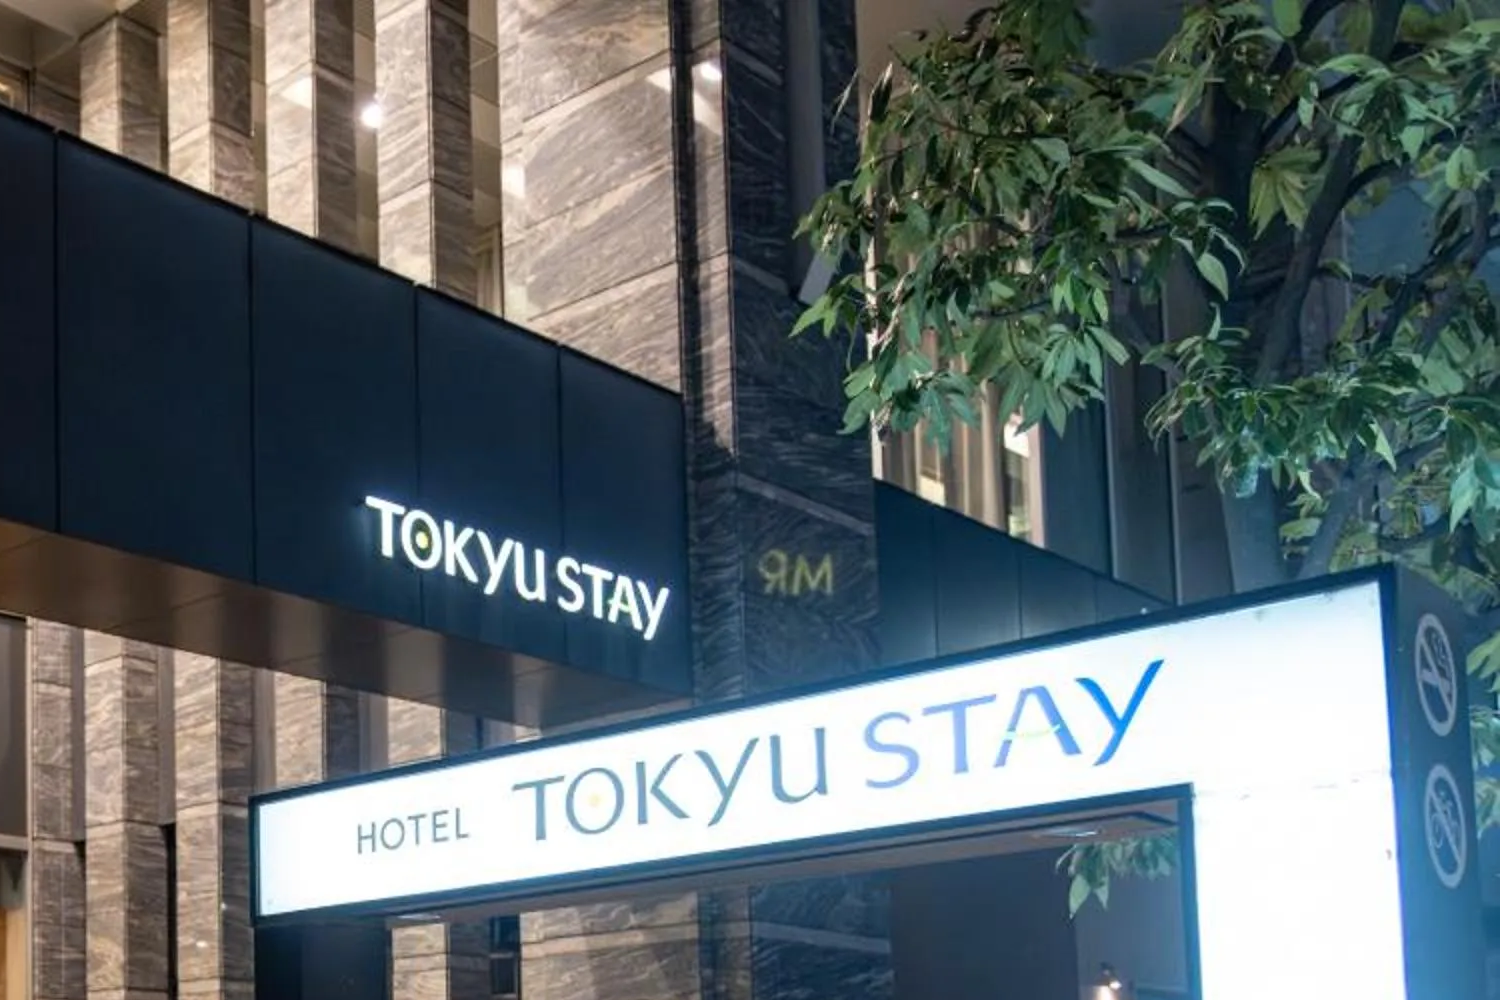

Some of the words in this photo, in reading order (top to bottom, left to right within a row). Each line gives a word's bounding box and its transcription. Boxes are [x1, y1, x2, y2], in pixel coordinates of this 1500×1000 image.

[364, 495, 547, 602] TOKYU
[556, 556, 670, 641] STAY
[356, 807, 470, 855] HOTEL
[511, 726, 828, 842] TOKYU
[863, 657, 1166, 790] STAY
